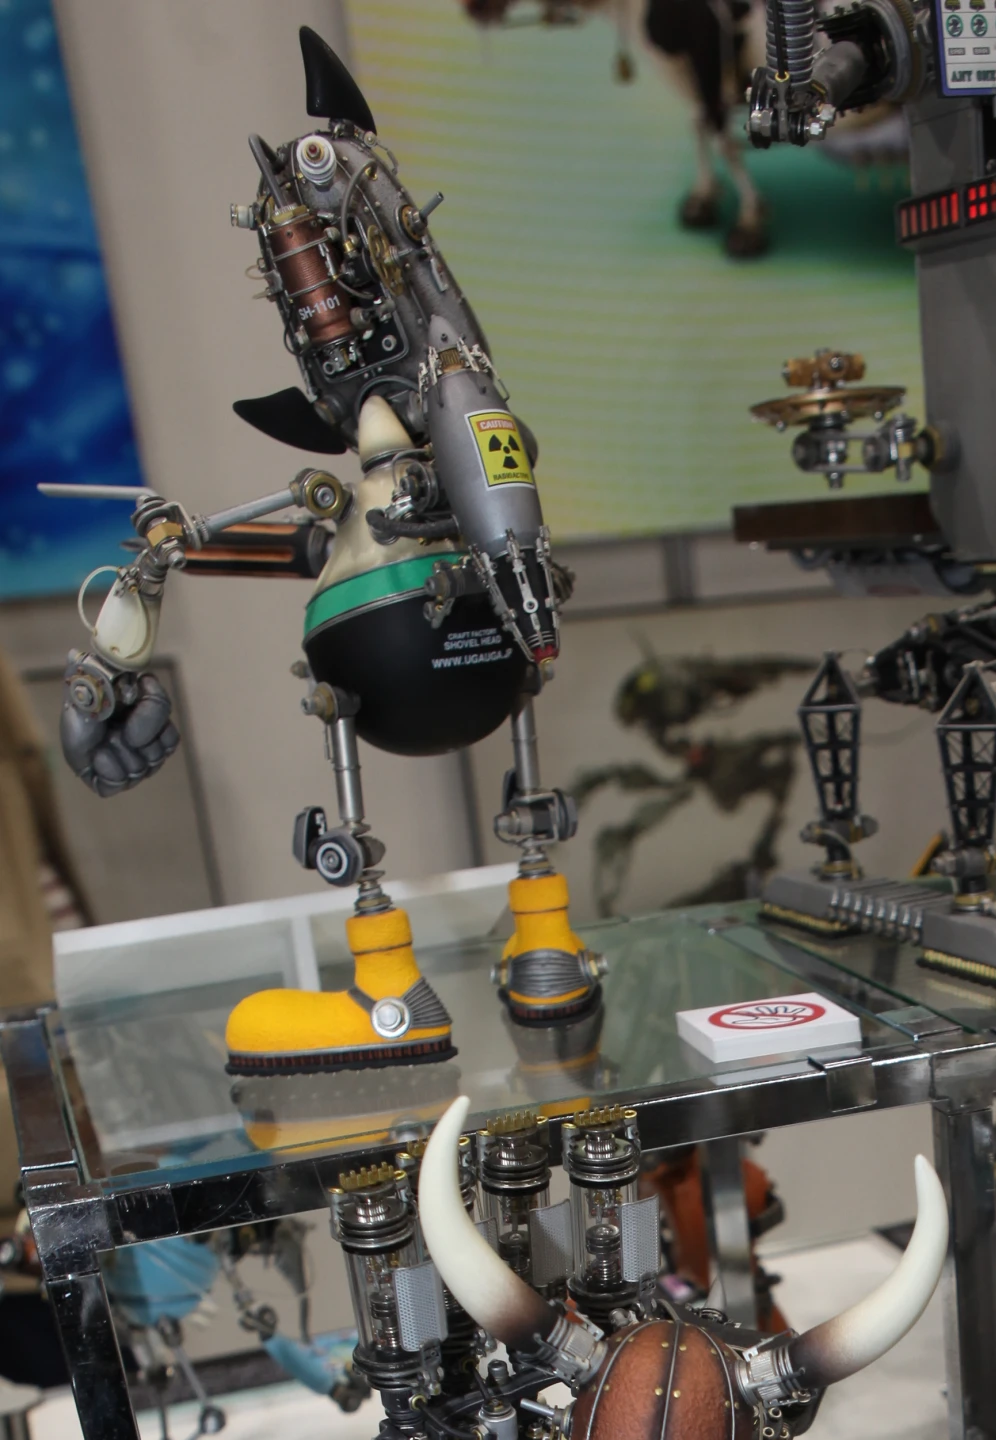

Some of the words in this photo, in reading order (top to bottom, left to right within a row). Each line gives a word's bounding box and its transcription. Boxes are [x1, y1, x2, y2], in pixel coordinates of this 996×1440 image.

[298, 294, 341, 321] SH-1101
[480, 419, 514, 430] CAUTION
[443, 638, 479, 651] SHOVEL
[481, 635, 502, 646] HEAD
